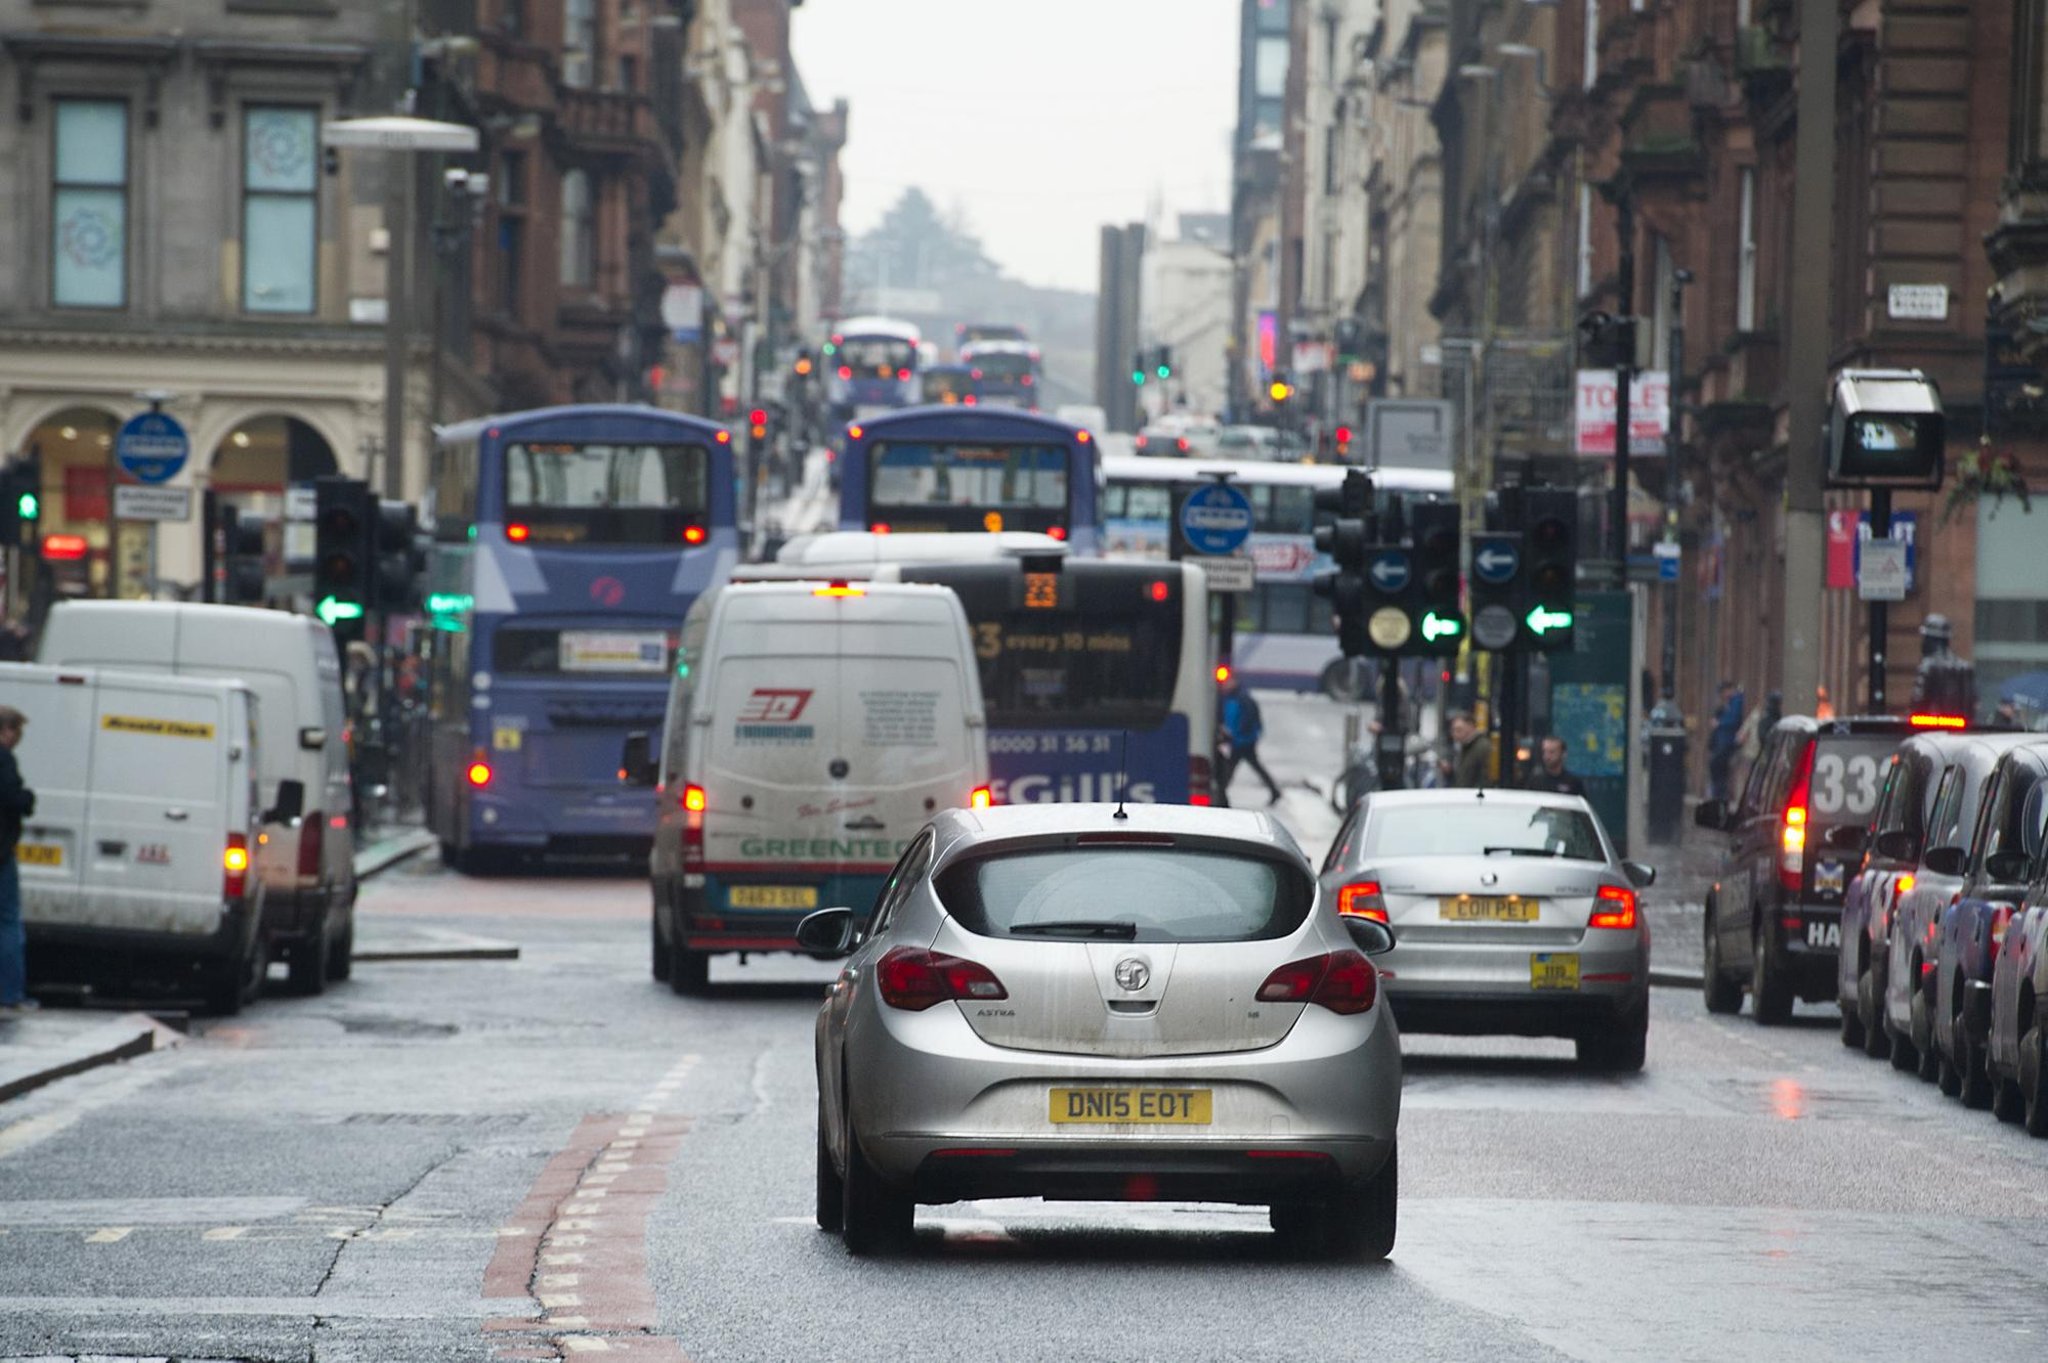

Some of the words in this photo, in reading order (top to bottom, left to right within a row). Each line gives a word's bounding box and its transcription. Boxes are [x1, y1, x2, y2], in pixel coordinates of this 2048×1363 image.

[1024, 572, 1057, 608] 23
[970, 622, 1002, 659] 3
[1006, 634, 1059, 654] every
[1063, 631, 1084, 651] 10
[1087, 630, 1131, 652] mins
[1813, 753, 1893, 815] 33
[1495, 898, 1529, 918] PET
[976, 1009, 1015, 1017] ASTRA
[1067, 1091, 1131, 1118] DN15
[1139, 1092, 1194, 1118] EOT
